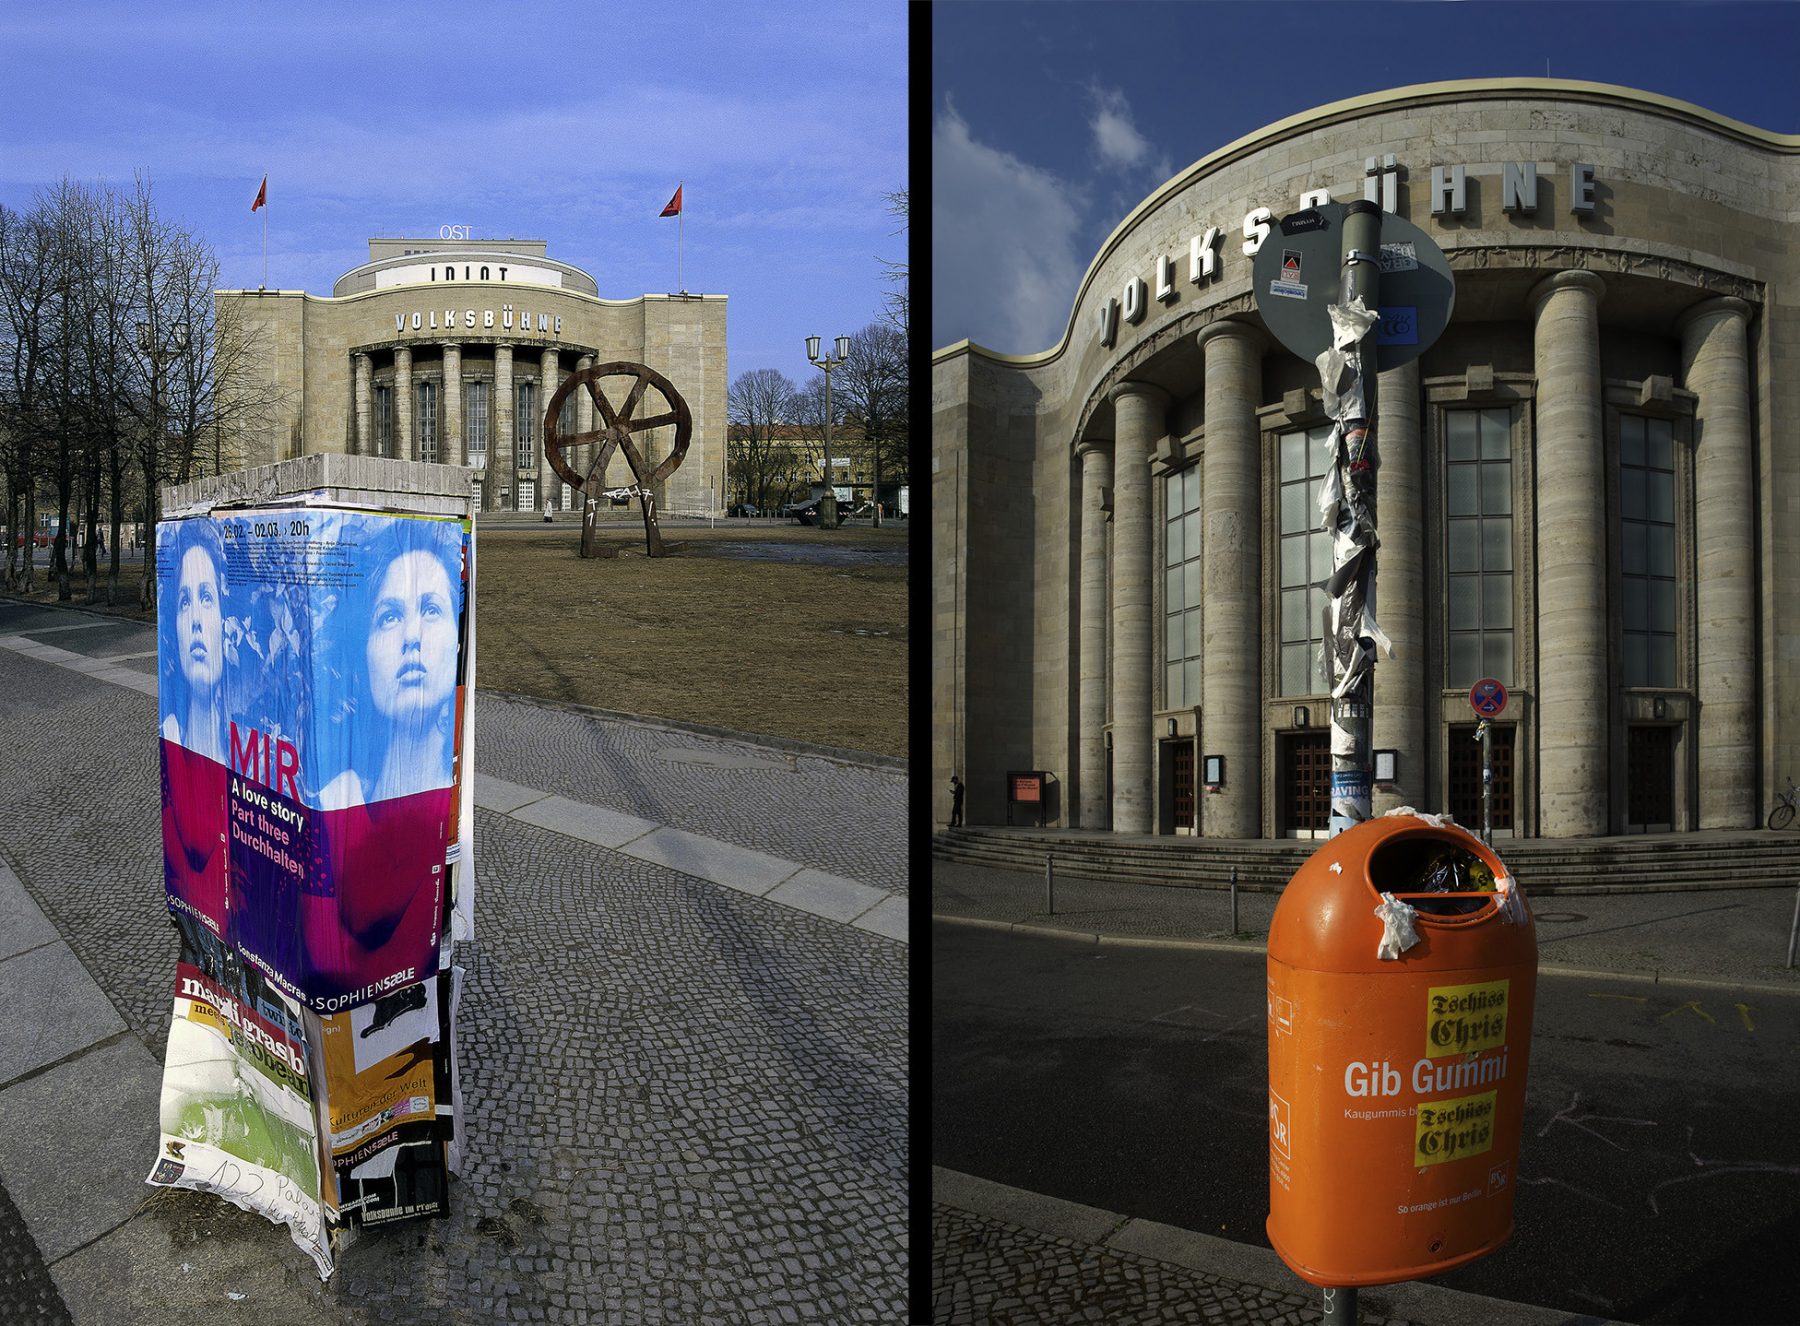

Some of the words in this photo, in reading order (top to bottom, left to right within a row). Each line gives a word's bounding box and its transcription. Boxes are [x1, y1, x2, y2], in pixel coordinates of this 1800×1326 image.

[439, 224, 473, 240] OST
[395, 304, 562, 333] VOLKSBÜHNE
[254, 522, 281, 537] 02.03.
[290, 520, 310, 537] 20h
[230, 721, 301, 800] MIR
[232, 778, 240, 797] A
[242, 782, 268, 810] love
[271, 801, 304, 833] story
[232, 798, 255, 827] Part
[258, 814, 290, 846] three
[232, 820, 304, 880] Durchhalten
[274, 973, 307, 1002] Macras
[1431, 990, 1505, 1016] Tschüss
[1430, 1014, 1504, 1050] Chris
[400, 1078, 426, 1093] Welt
[1344, 1061, 1402, 1097] Gib
[1411, 1045, 1509, 1094] Gummi
[1344, 1108, 1407, 1120] Kaugummis
[1420, 1101, 1493, 1127] Tschüss
[1418, 1122, 1490, 1157] Chris
[1398, 1205, 1409, 1215] So
[1410, 1201, 1437, 1214] orange
[1438, 1198, 1449, 1207] ist
